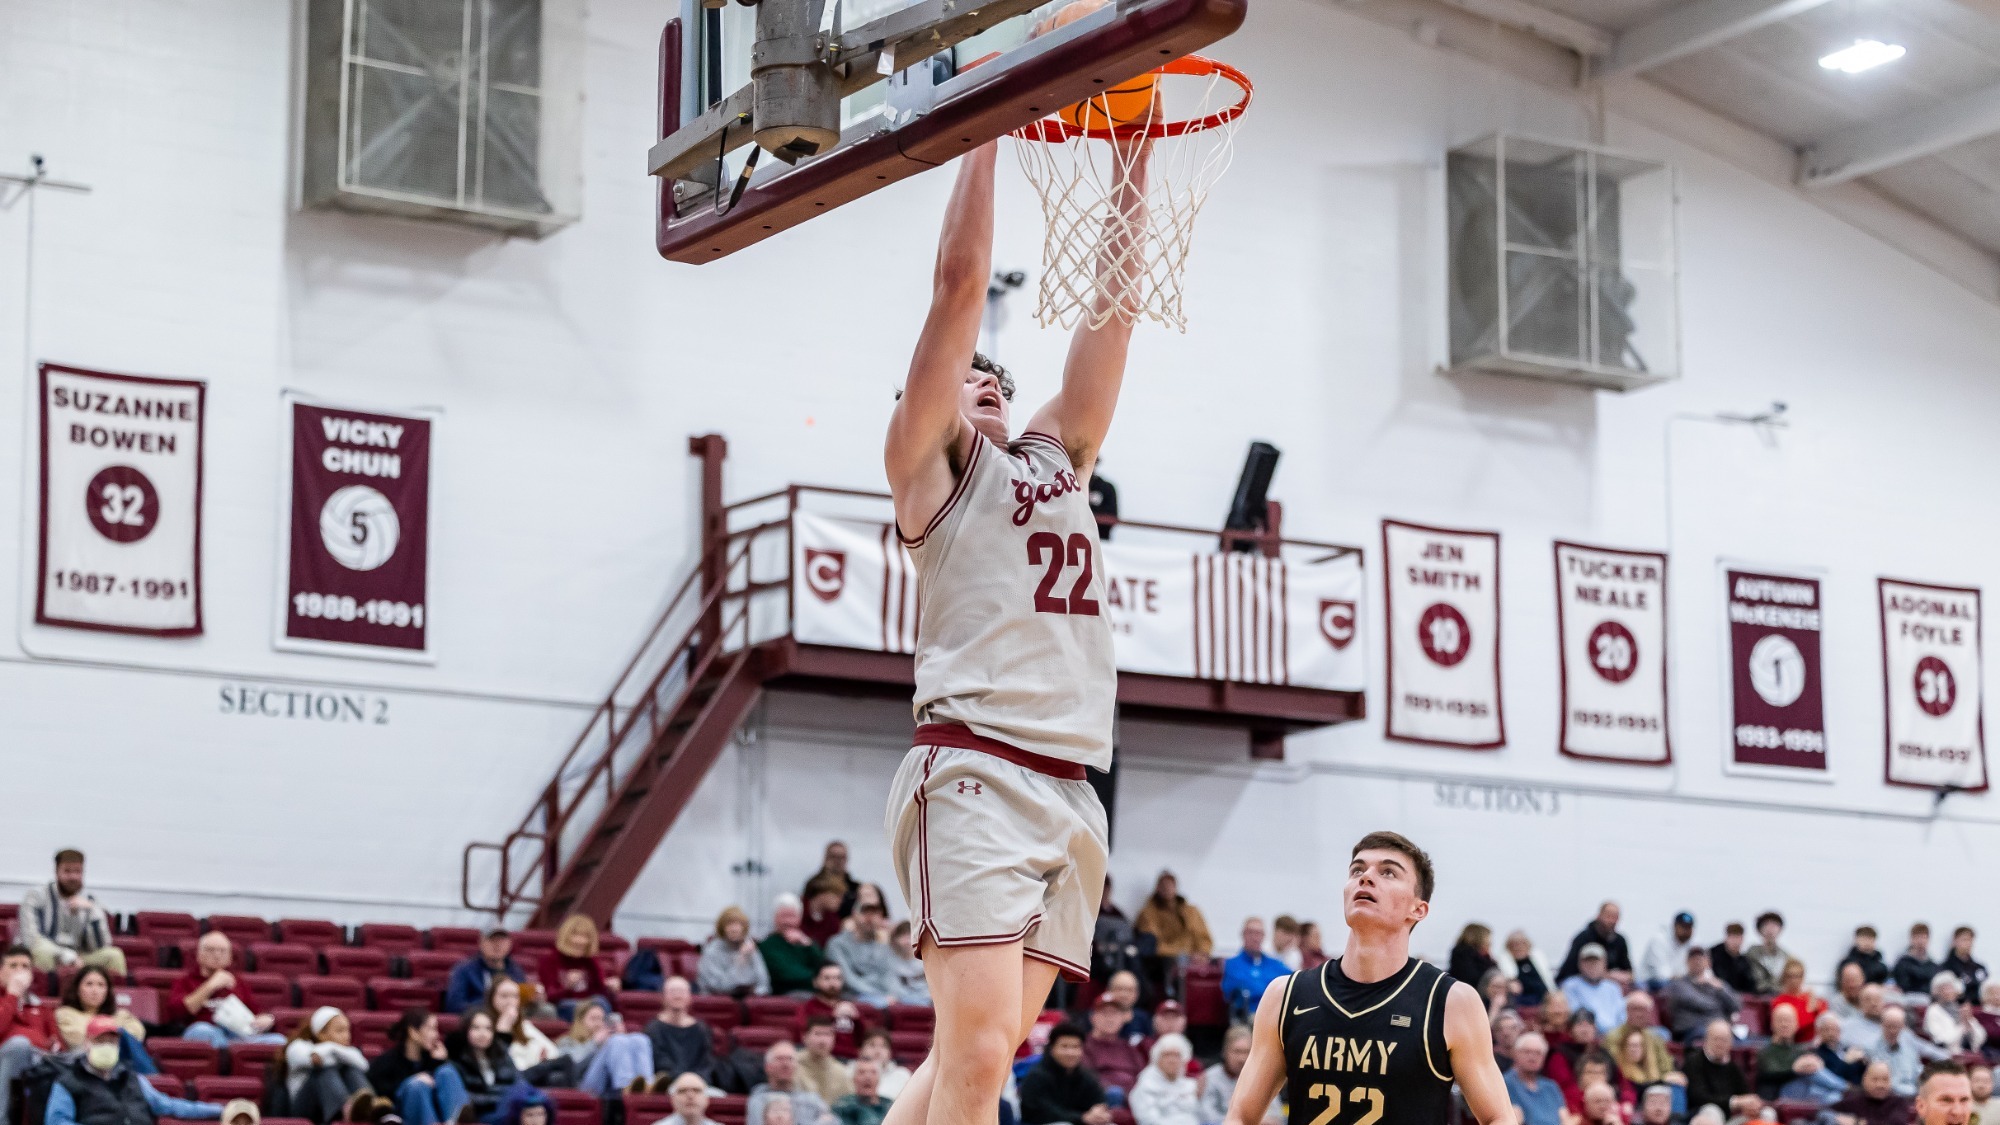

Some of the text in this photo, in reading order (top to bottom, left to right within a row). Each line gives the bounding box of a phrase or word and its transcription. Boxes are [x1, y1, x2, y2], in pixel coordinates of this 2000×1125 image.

[53, 386, 193, 422] SUZANNE
[70, 424, 176, 453] BOWEN
[321, 416, 403, 449] VICKY
[322, 447, 401, 479] CHUN
[101, 482, 144, 526] 32
[352, 512, 367, 544] 5
[1420, 542, 1463, 562] JEN
[54, 571, 189, 599] 1987-1991
[1027, 532, 1100, 616] 22
[1407, 566, 1481, 591] SMITH
[1567, 557, 1657, 583] TUCKER
[1106, 578, 1159, 613] ATE
[1575, 585, 1648, 611] NEALE
[1735, 577, 1815, 606] AUTUMN
[1888, 595, 1973, 621] ADONAL
[294, 592, 424, 629] 1988-1991
[1429, 616, 1462, 654] 10
[1900, 621, 1962, 645] FOYLE
[1596, 633, 1630, 671] 20
[1919, 668, 1949, 704] 31
[219, 685, 390, 724] SECTION 2
[1433, 781, 1542, 815] SECTION
[1298, 1035, 1398, 1075] ARMY
[1308, 1083, 1385, 1125] 22
